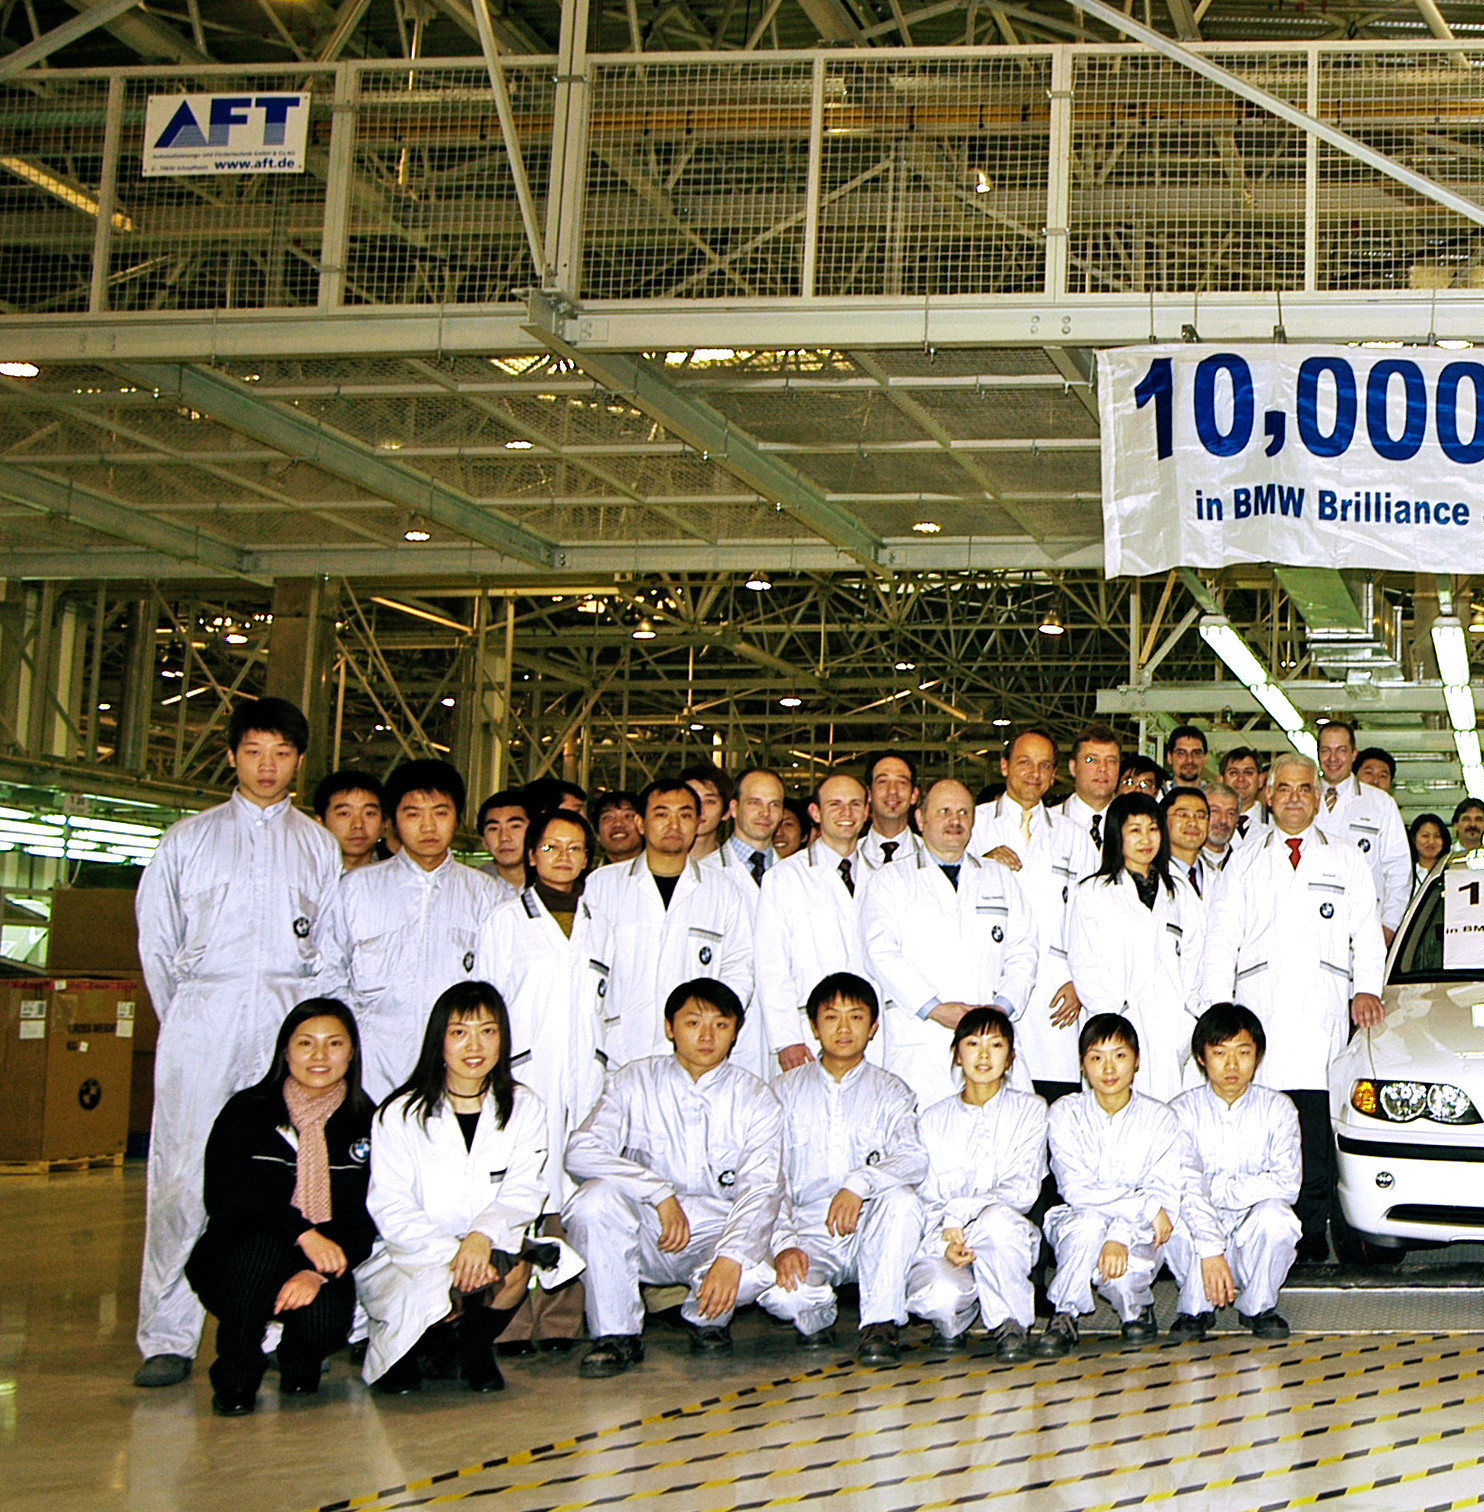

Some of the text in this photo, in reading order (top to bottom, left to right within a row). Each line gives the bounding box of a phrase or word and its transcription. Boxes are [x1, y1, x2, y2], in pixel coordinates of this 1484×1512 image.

[154, 97, 300, 148] AFT
[214, 157, 295, 170] www.aft.de
[1196, 490, 1223, 521] in
[1233, 484, 1306, 519] BMW
[1318, 489, 1470, 526] Brilliance
[1445, 926, 1459, 935] in
